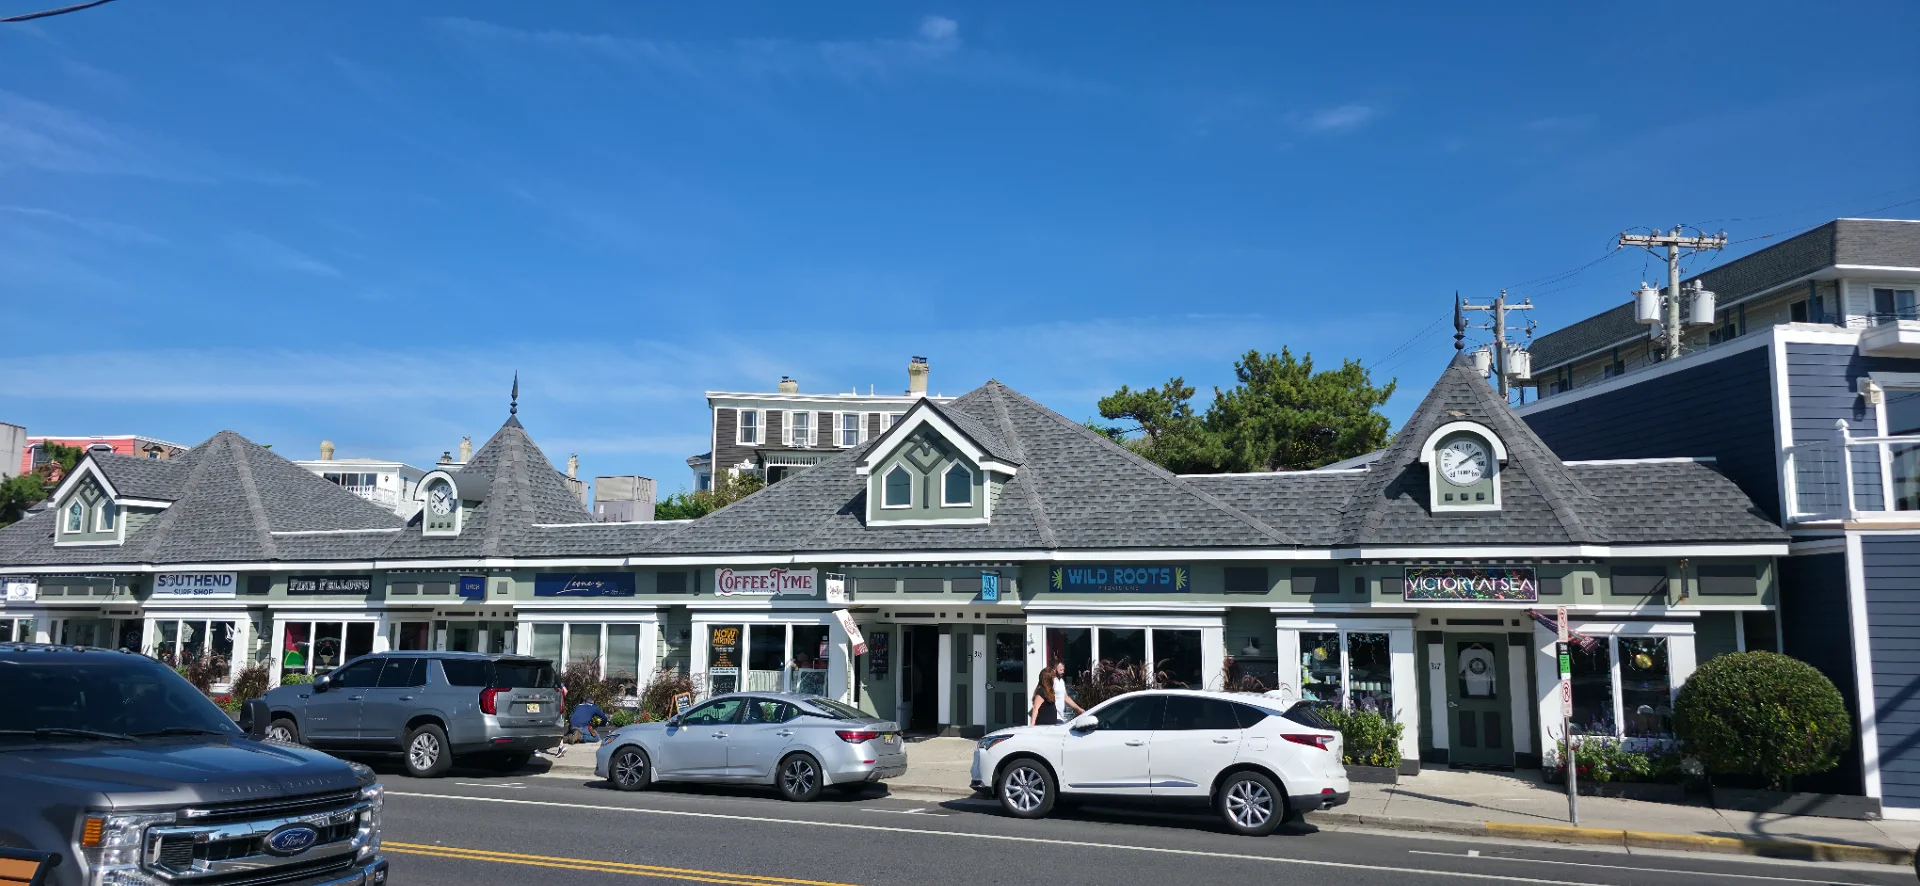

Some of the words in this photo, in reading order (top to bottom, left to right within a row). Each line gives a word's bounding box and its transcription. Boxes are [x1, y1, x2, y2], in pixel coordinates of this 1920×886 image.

[157, 574, 233, 587] SOUTHEND
[718, 569, 769, 593] COFFEE
[769, 568, 812, 594] TYME
[1067, 568, 1108, 584] WILD
[1113, 568, 1170, 584] ROOTS
[289, 579, 316, 591] FINE
[319, 579, 370, 591] FELLOWS
[1407, 577, 1478, 591] VICTORY
[1478, 577, 1499, 591] AT
[1500, 577, 1534, 591] SEA
[173, 588, 192, 596] SURF
[193, 588, 214, 596] SHOP
[713, 628, 737, 639] NOW
[712, 636, 736, 646] HIRING
[281, 832, 308, 848] Ford
